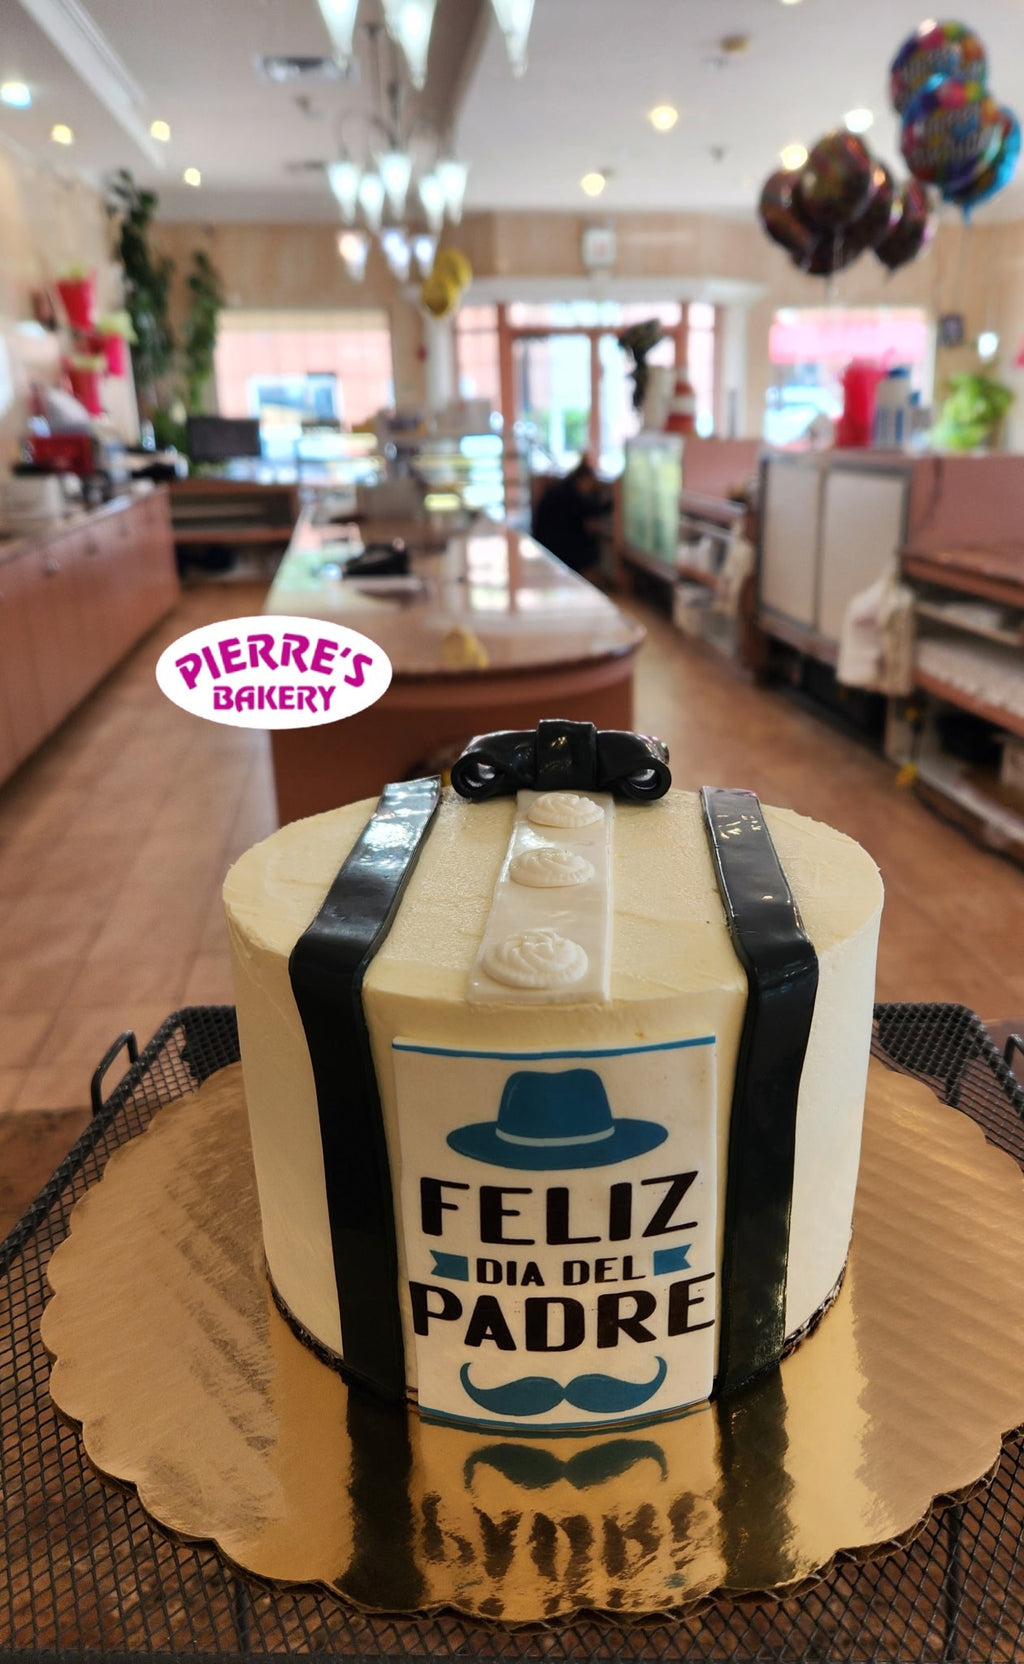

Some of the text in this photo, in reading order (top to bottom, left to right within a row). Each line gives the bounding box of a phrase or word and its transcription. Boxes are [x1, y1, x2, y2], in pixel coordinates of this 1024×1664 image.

[419, 1170, 699, 1246] FELIZ
[476, 1255, 646, 1287] DIA DEL
[408, 1271, 716, 1353] PADRE
